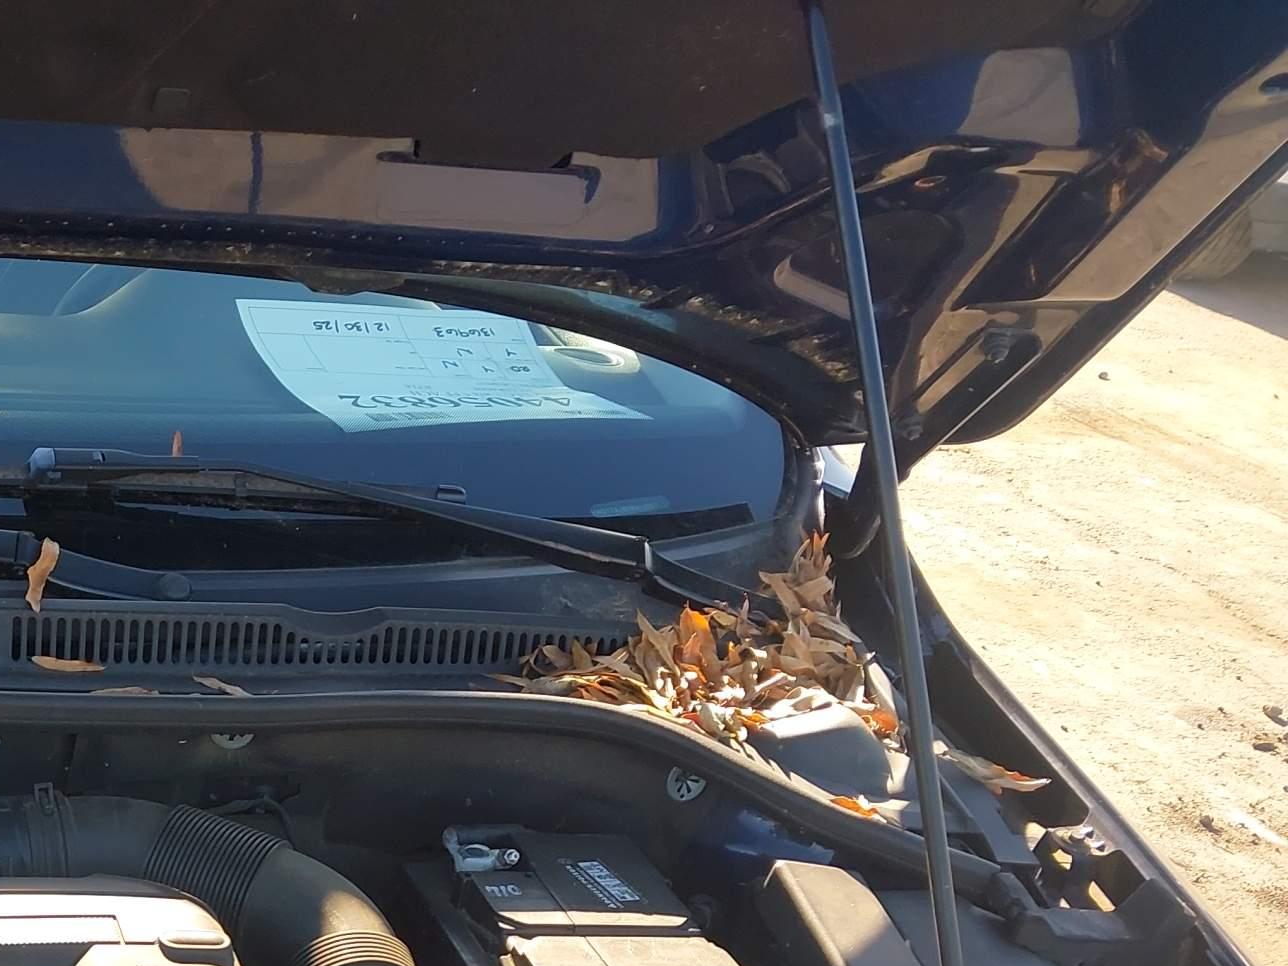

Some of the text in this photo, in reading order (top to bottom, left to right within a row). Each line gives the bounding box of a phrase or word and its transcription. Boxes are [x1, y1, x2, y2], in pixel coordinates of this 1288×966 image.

[312, 319, 391, 334] 12/30/25
[433, 327, 495, 338] 136963
[337, 394, 571, 409] 44056832
